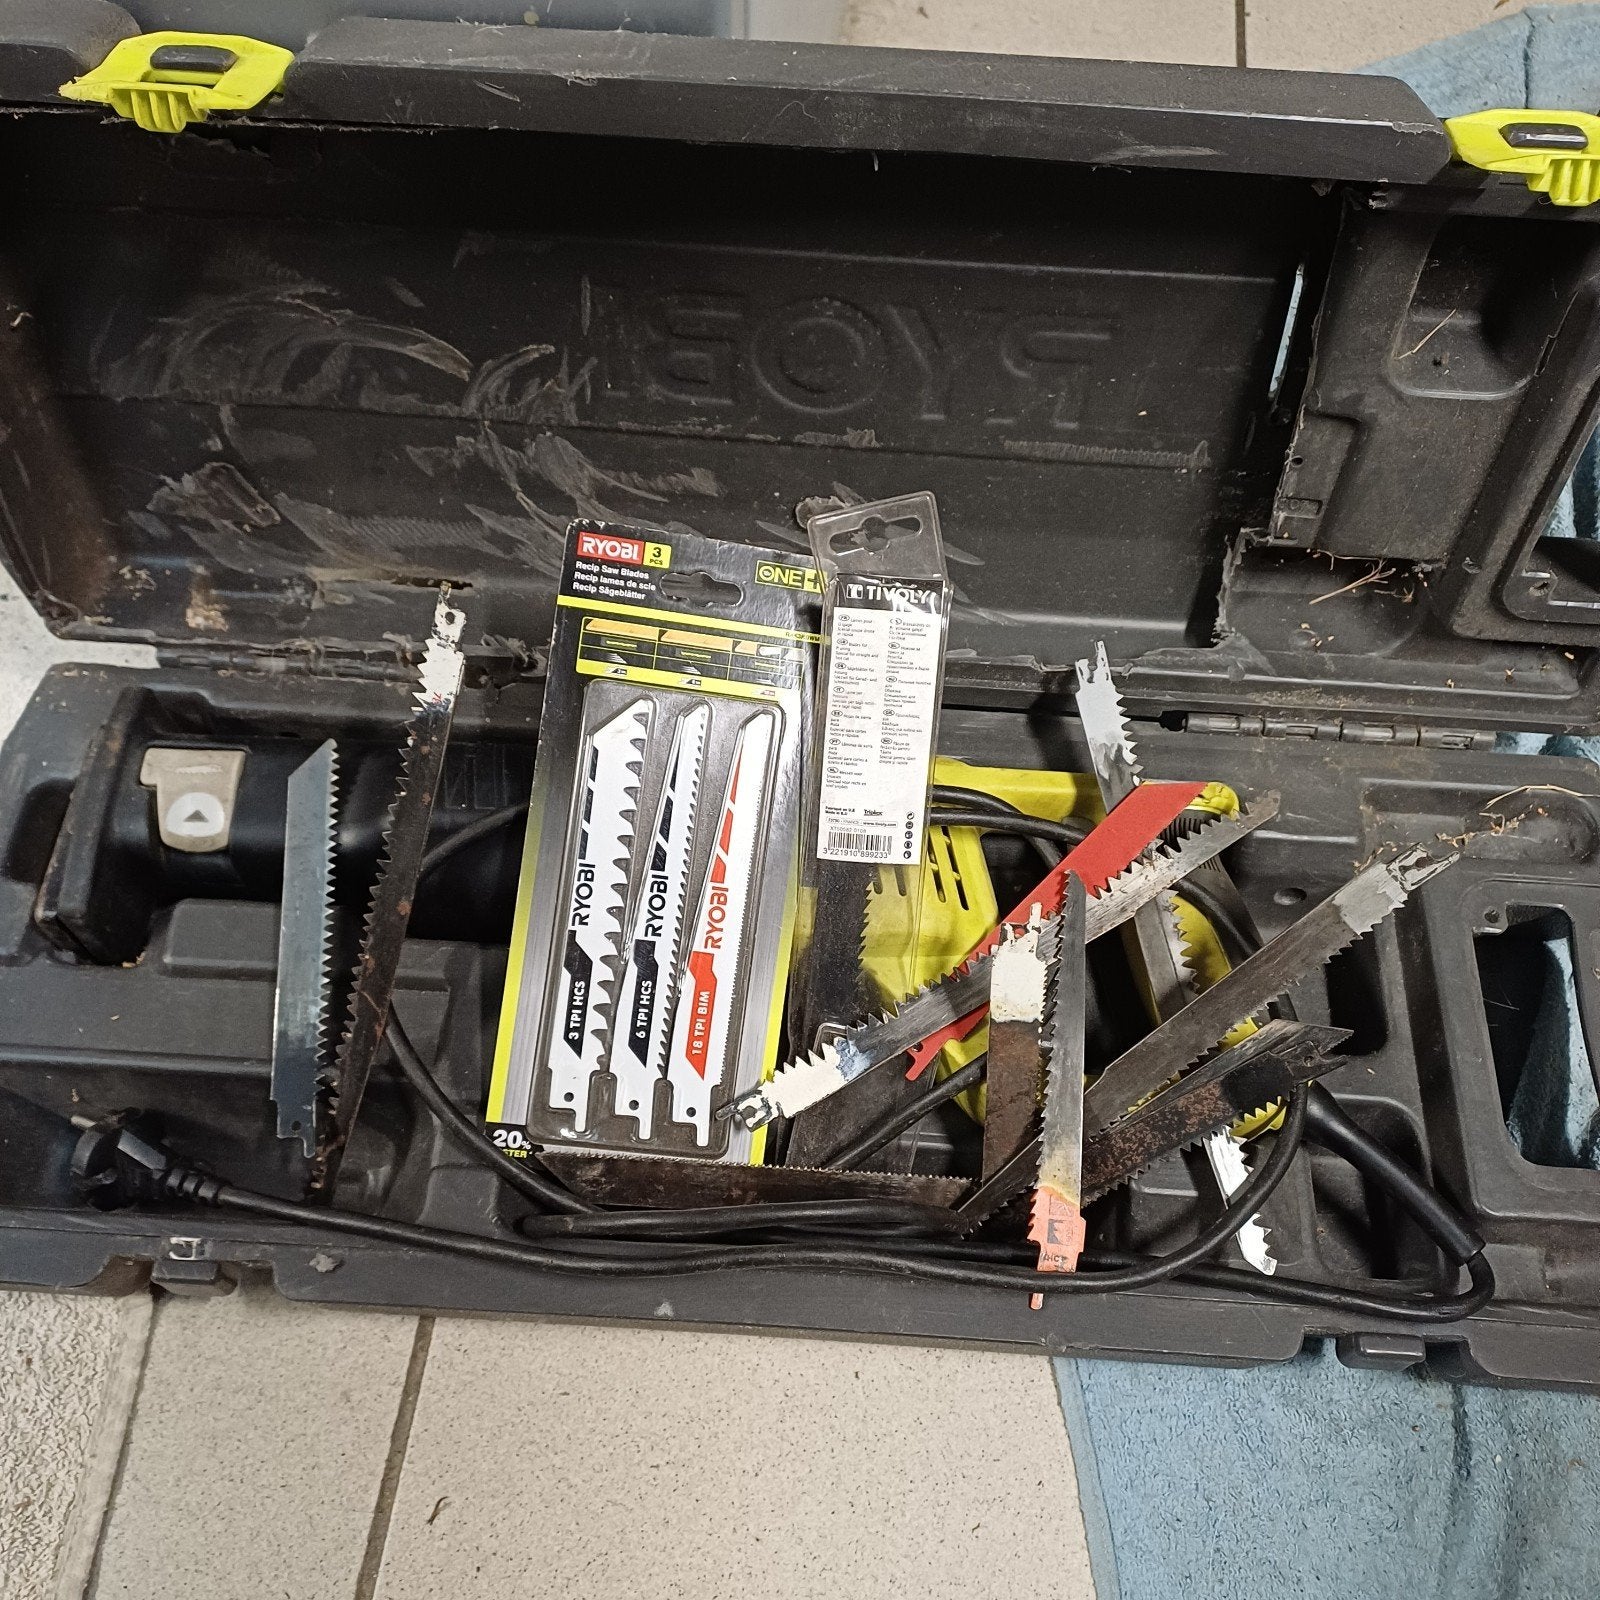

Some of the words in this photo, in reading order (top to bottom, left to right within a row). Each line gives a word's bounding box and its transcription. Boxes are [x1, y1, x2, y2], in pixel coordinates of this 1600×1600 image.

[582, 536, 639, 560] RYOBI
[652, 546, 662, 559] 3
[575, 561, 600, 573] Recip
[601, 564, 619, 575] Saw
[620, 567, 649, 580] Blades
[649, 558, 663, 566] PCS
[572, 581, 597, 593] Recip
[574, 571, 598, 583] Recip
[600, 575, 625, 587] lames
[626, 579, 637, 589] de
[638, 581, 656, 591] scie
[866, 585, 931, 604] TIVOLY
[823, 847, 828, 855] 3
[830, 848, 858, 857] 221910
[860, 850, 888, 859] 899233
[572, 863, 596, 926] RYOBI
[644, 875, 669, 938] RYOBI
[704, 887, 729, 950] RYOBI
[573, 980, 585, 1006] HCS
[640, 980, 653, 1005] HCS
[697, 991, 710, 1015] BIM
[570, 1010, 582, 1029] TPI
[636, 1008, 649, 1027] TPI
[568, 1032, 579, 1040] 3
[636, 1030, 646, 1039] 6
[694, 1018, 706, 1037] TPI
[692, 1041, 703, 1055] 18
[492, 1129, 532, 1150] 20%
